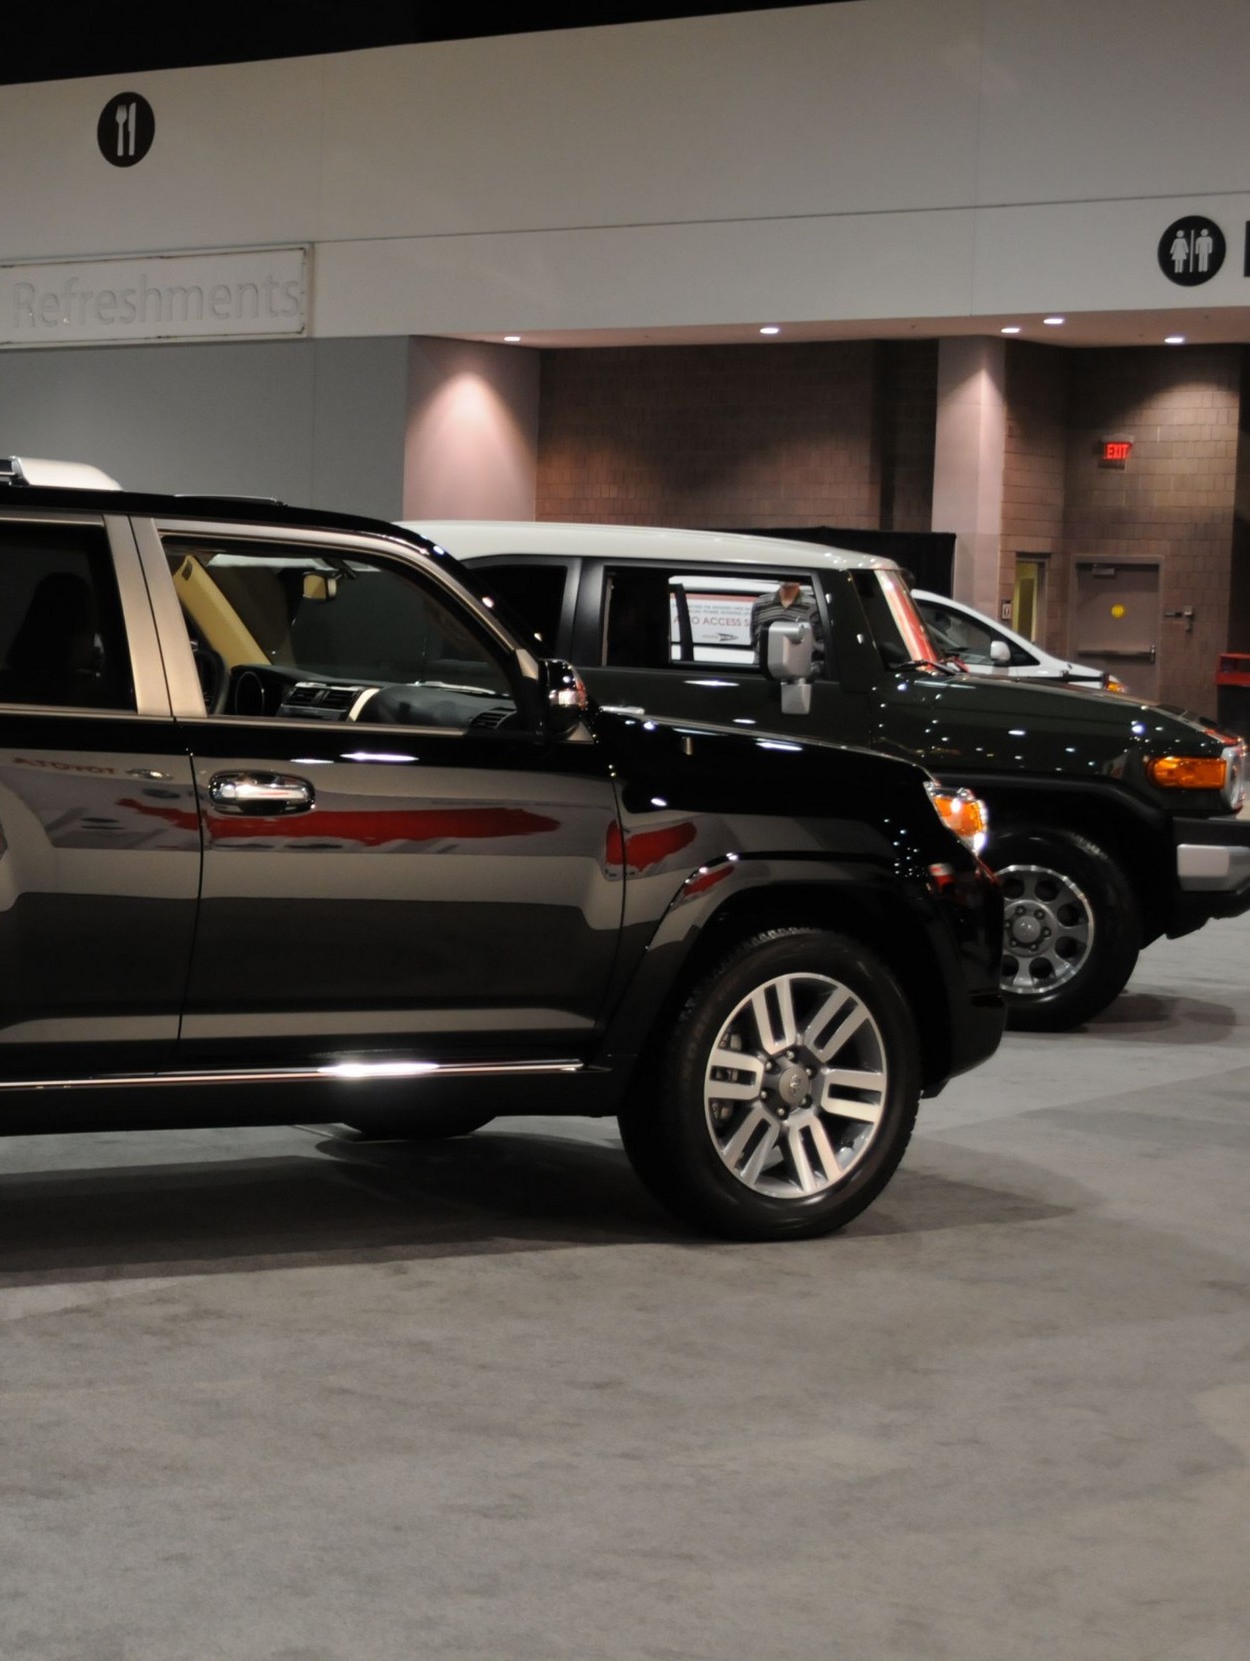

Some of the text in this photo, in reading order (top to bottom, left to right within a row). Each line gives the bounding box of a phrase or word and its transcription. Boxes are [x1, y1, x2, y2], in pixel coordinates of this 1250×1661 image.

[11, 273, 301, 329] Refreshments
[1106, 443, 1129, 460] EXIT
[702, 616, 743, 628] ACCESS
